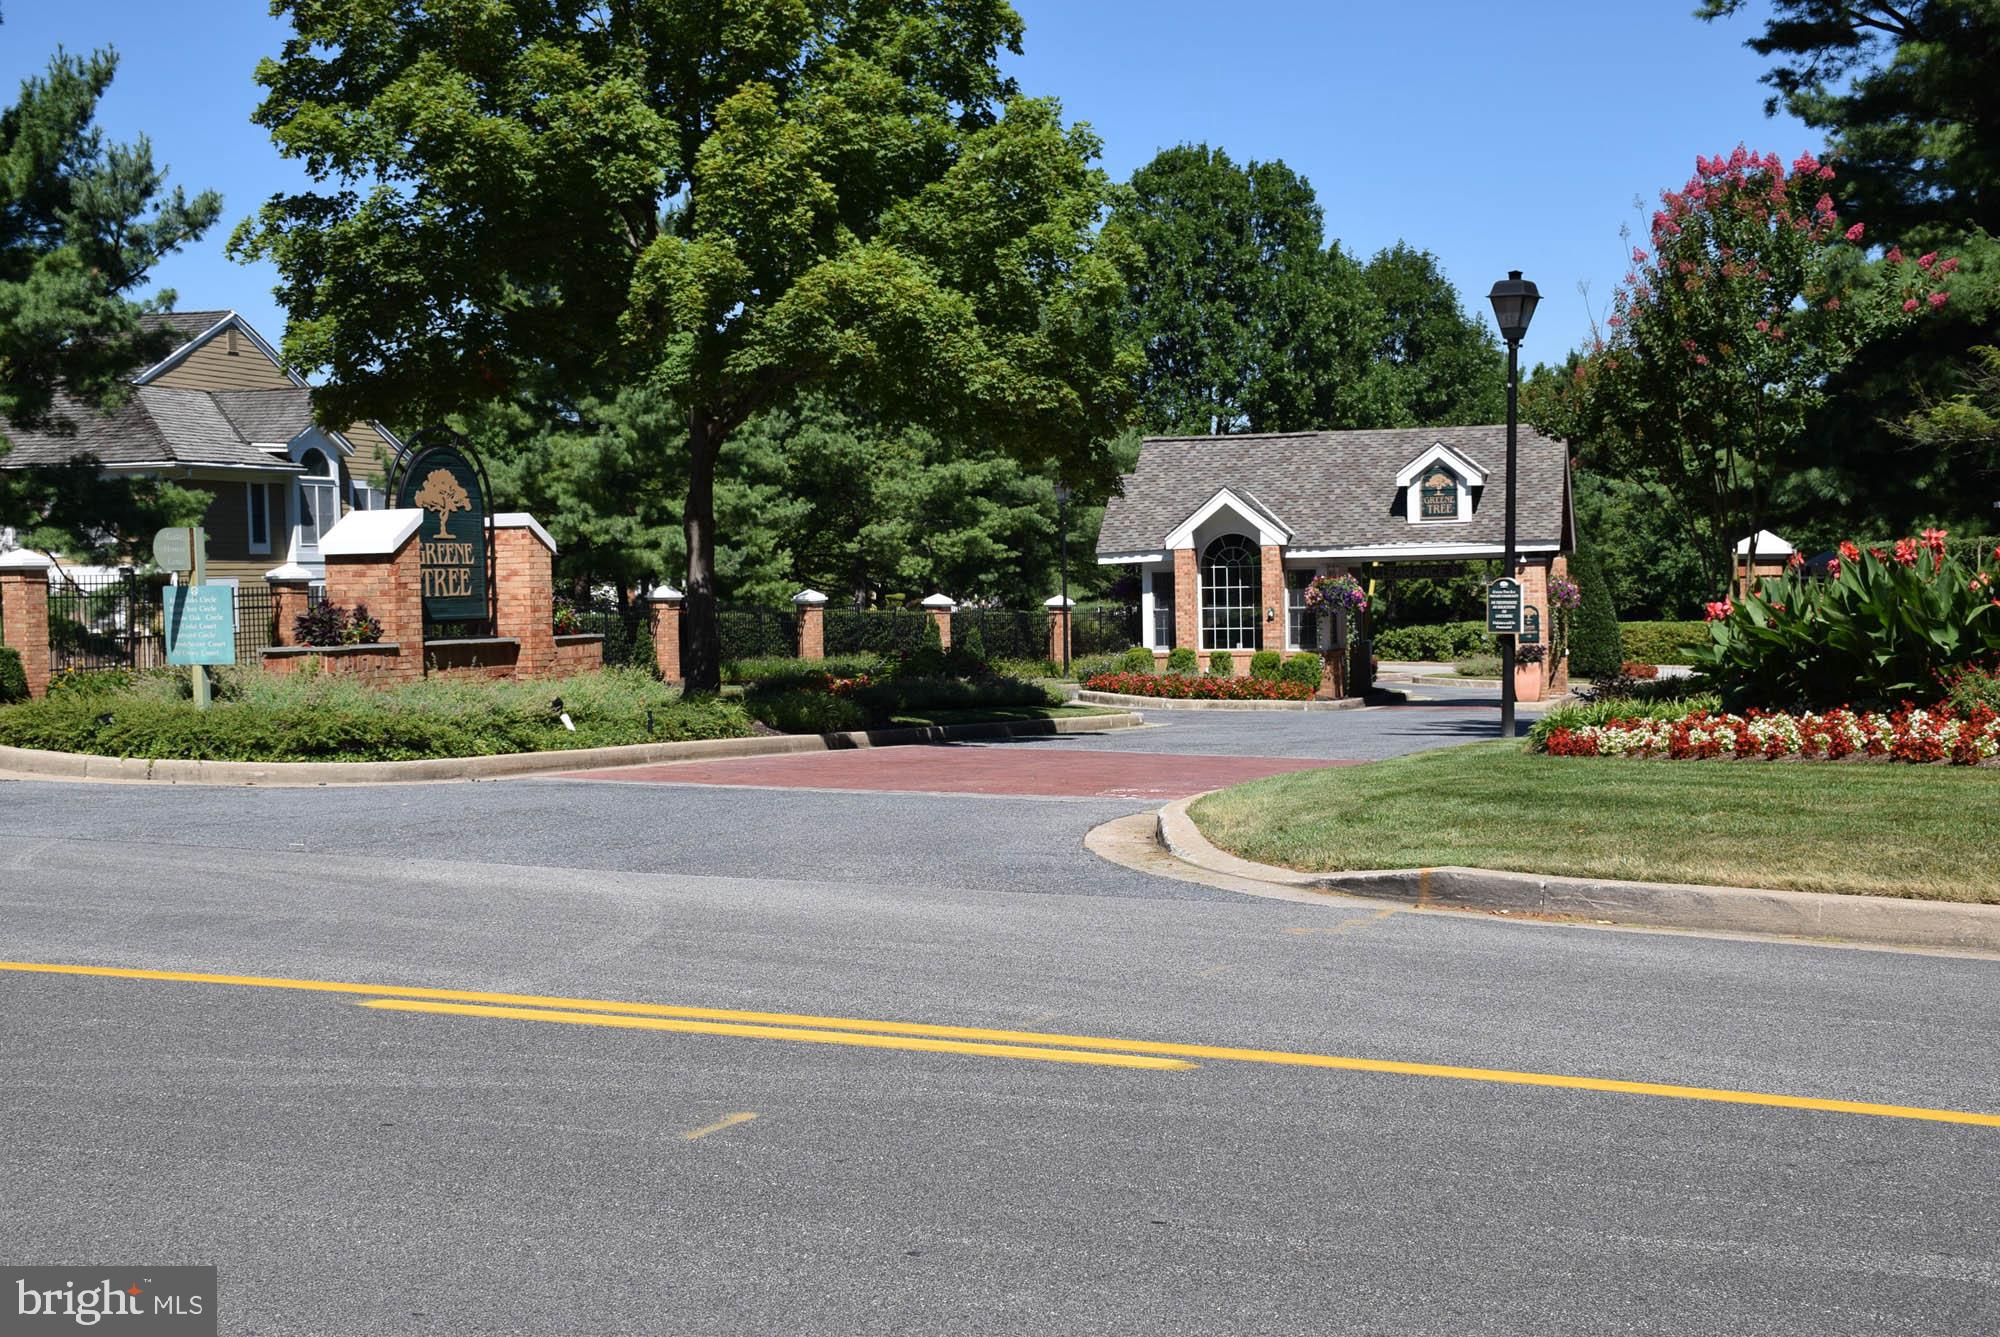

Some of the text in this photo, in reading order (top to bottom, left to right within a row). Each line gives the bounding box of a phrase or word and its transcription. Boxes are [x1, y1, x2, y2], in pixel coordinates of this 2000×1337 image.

[1423, 496, 1455, 504] GREENE
[1427, 504, 1453, 514] TREE
[421, 568, 472, 598] TREE
